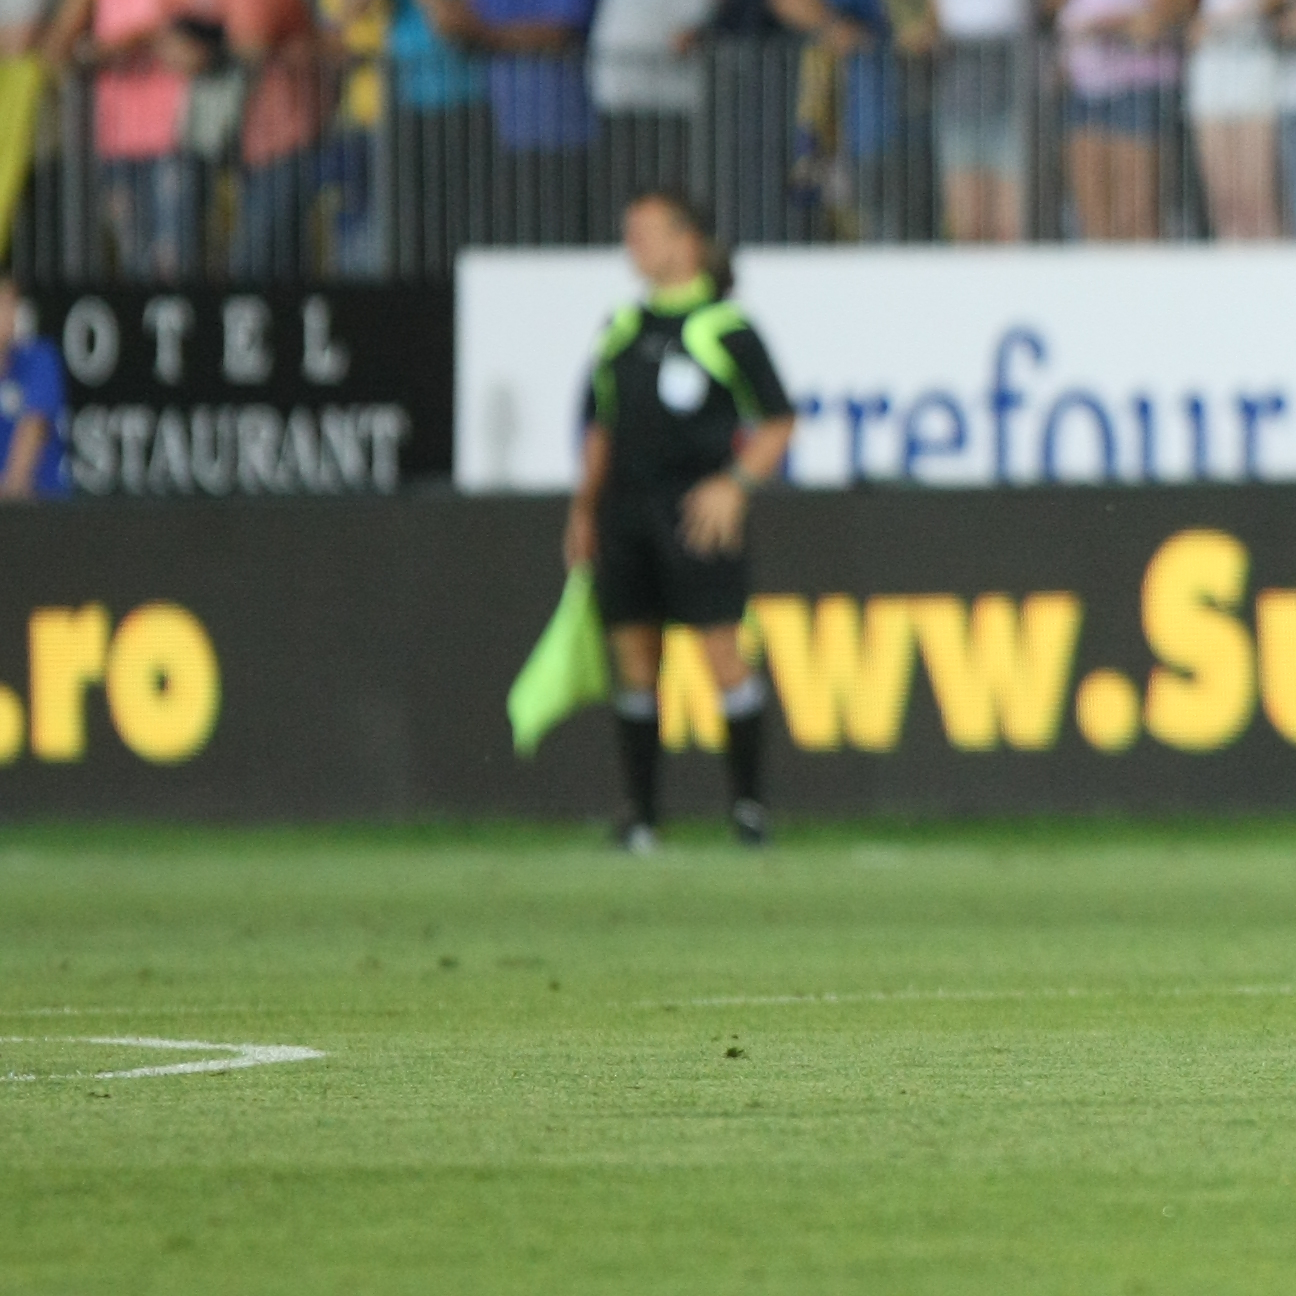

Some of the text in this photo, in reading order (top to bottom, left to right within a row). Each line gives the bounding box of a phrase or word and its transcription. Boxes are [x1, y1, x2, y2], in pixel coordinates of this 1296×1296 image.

[13, 294, 352, 388] OTEL
[782, 317, 1290, 484] rrefour
[60, 402, 412, 497] STAURANT
